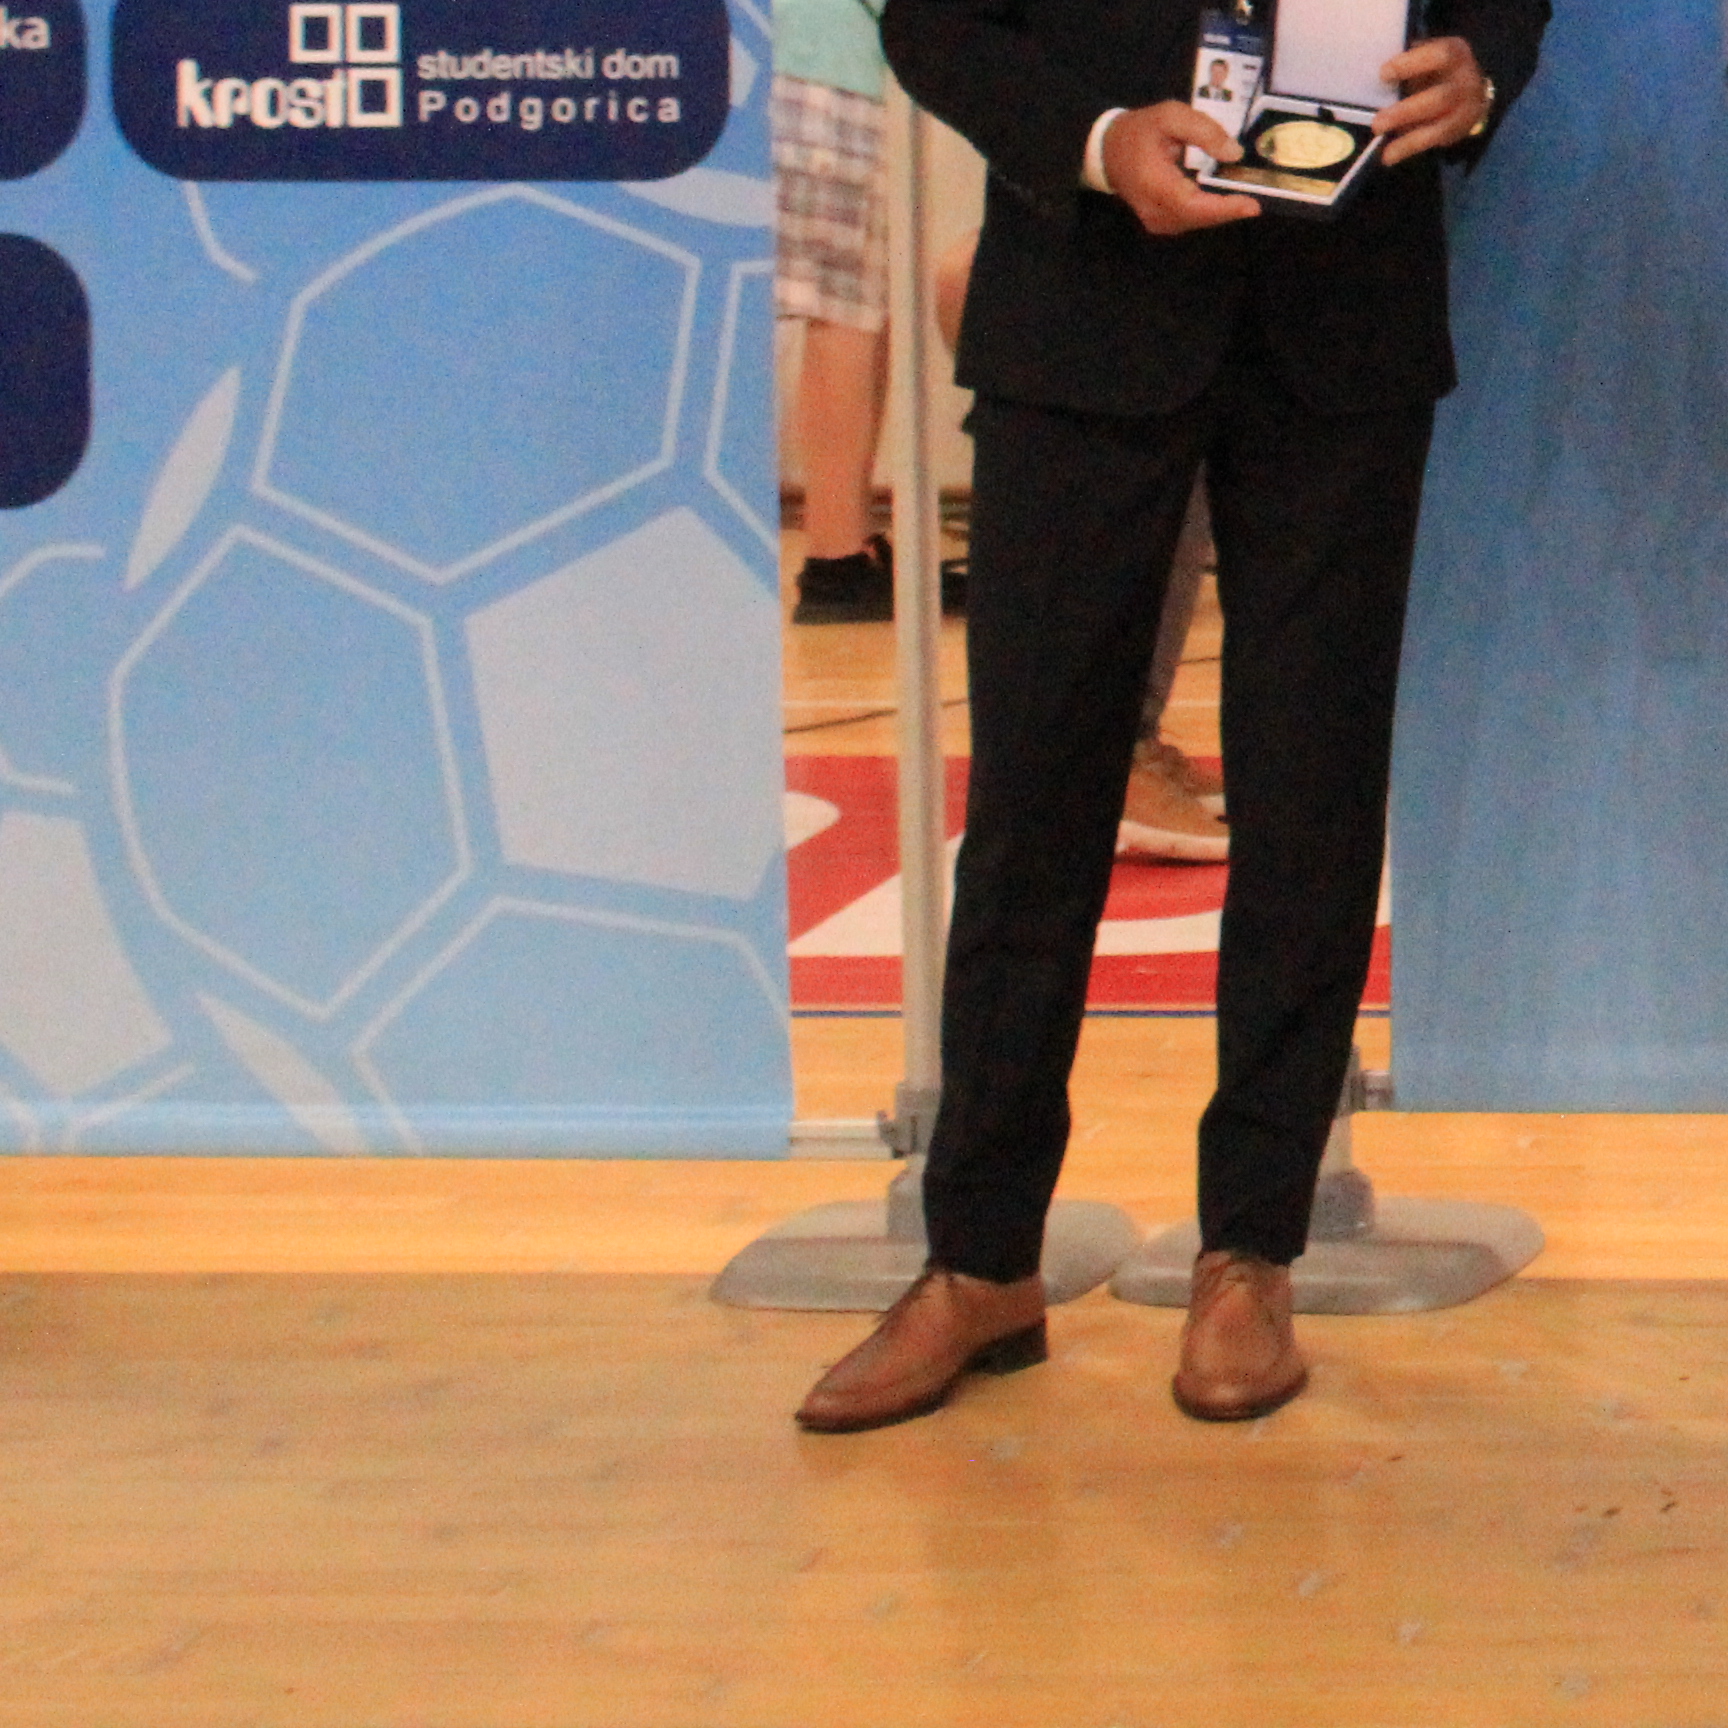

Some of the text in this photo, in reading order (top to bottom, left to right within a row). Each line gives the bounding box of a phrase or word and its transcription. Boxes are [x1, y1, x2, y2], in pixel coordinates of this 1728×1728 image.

[416, 49, 595, 81] studentski
[601, 49, 680, 80] dom
[417, 90, 682, 133] Podgorica
